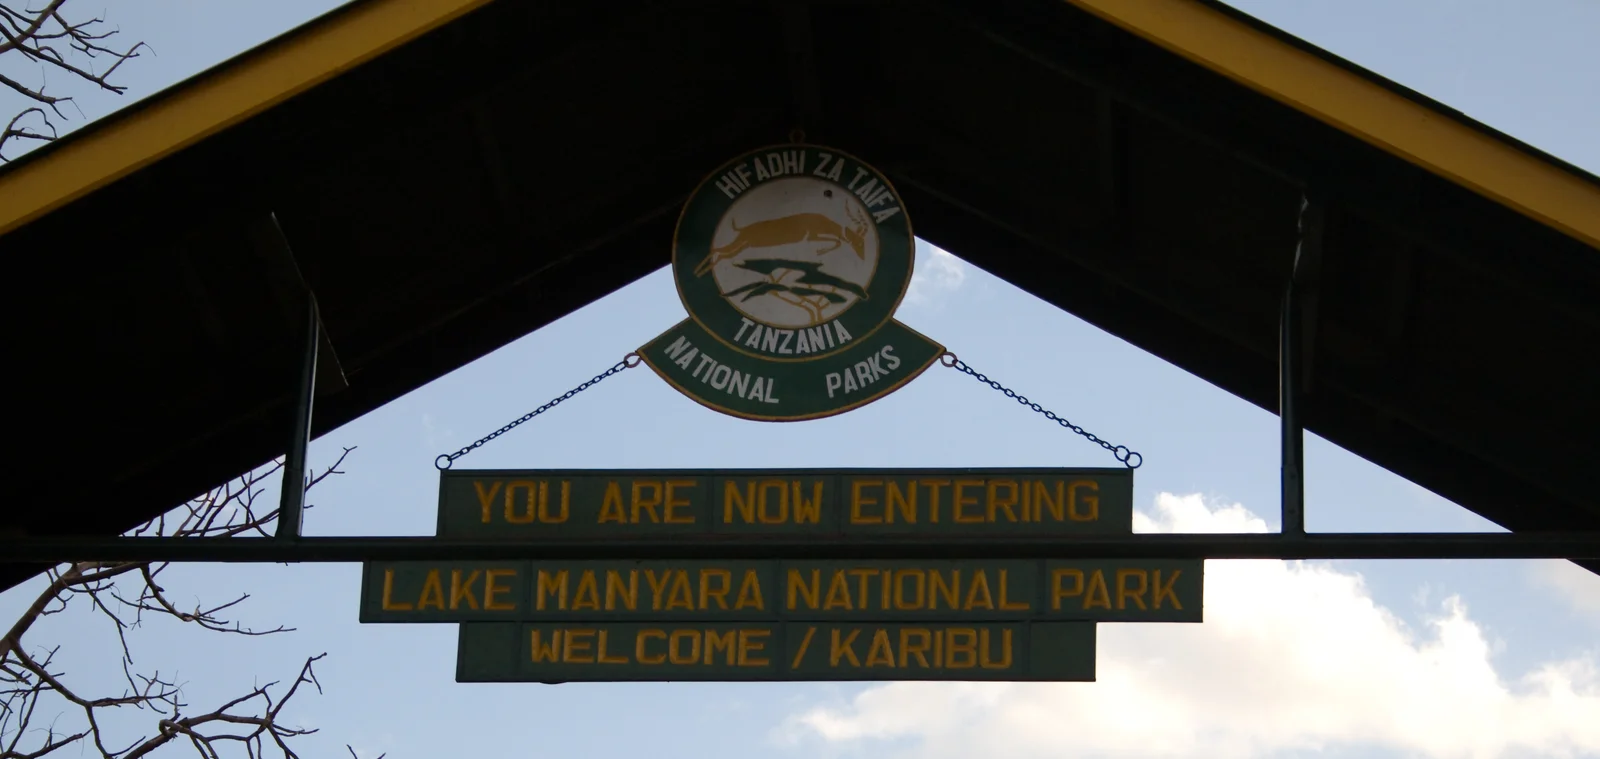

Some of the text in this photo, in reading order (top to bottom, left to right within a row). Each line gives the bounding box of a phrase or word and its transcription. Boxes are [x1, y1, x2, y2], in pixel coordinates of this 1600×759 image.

[715, 150, 900, 224] HIFADHI ZA TAIFA
[733, 317, 852, 354] TANZANIA
[664, 335, 901, 403] NATIONAL PARKS
[474, 479, 1100, 525] YOU ARE NOW ENTERING
[382, 568, 1183, 611] LAKE MANYARA NATIONAL PARK
[531, 627, 1013, 669] WELCOME / KARIBU
